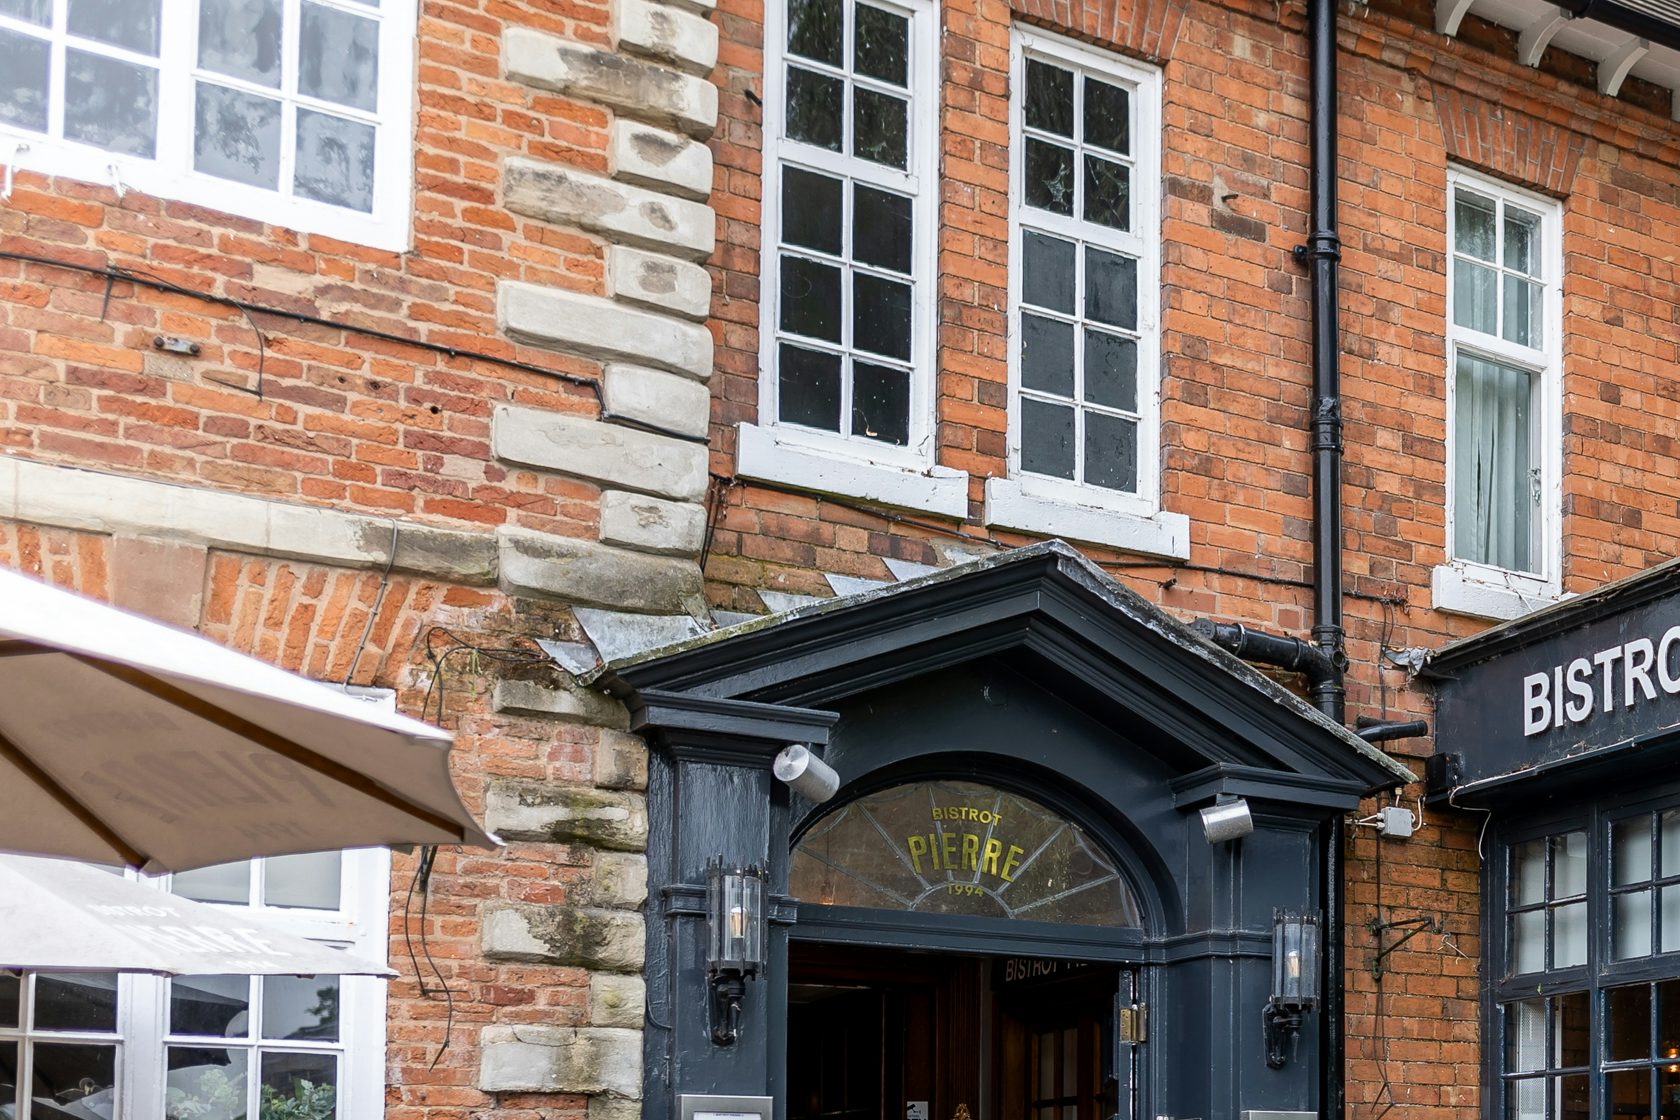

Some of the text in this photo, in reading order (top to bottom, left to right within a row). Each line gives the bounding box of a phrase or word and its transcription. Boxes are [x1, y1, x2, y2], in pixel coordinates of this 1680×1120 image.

[932, 806, 1002, 827] BISTROT
[907, 832, 1025, 883] PIERRE
[948, 884, 984, 897] 1994
